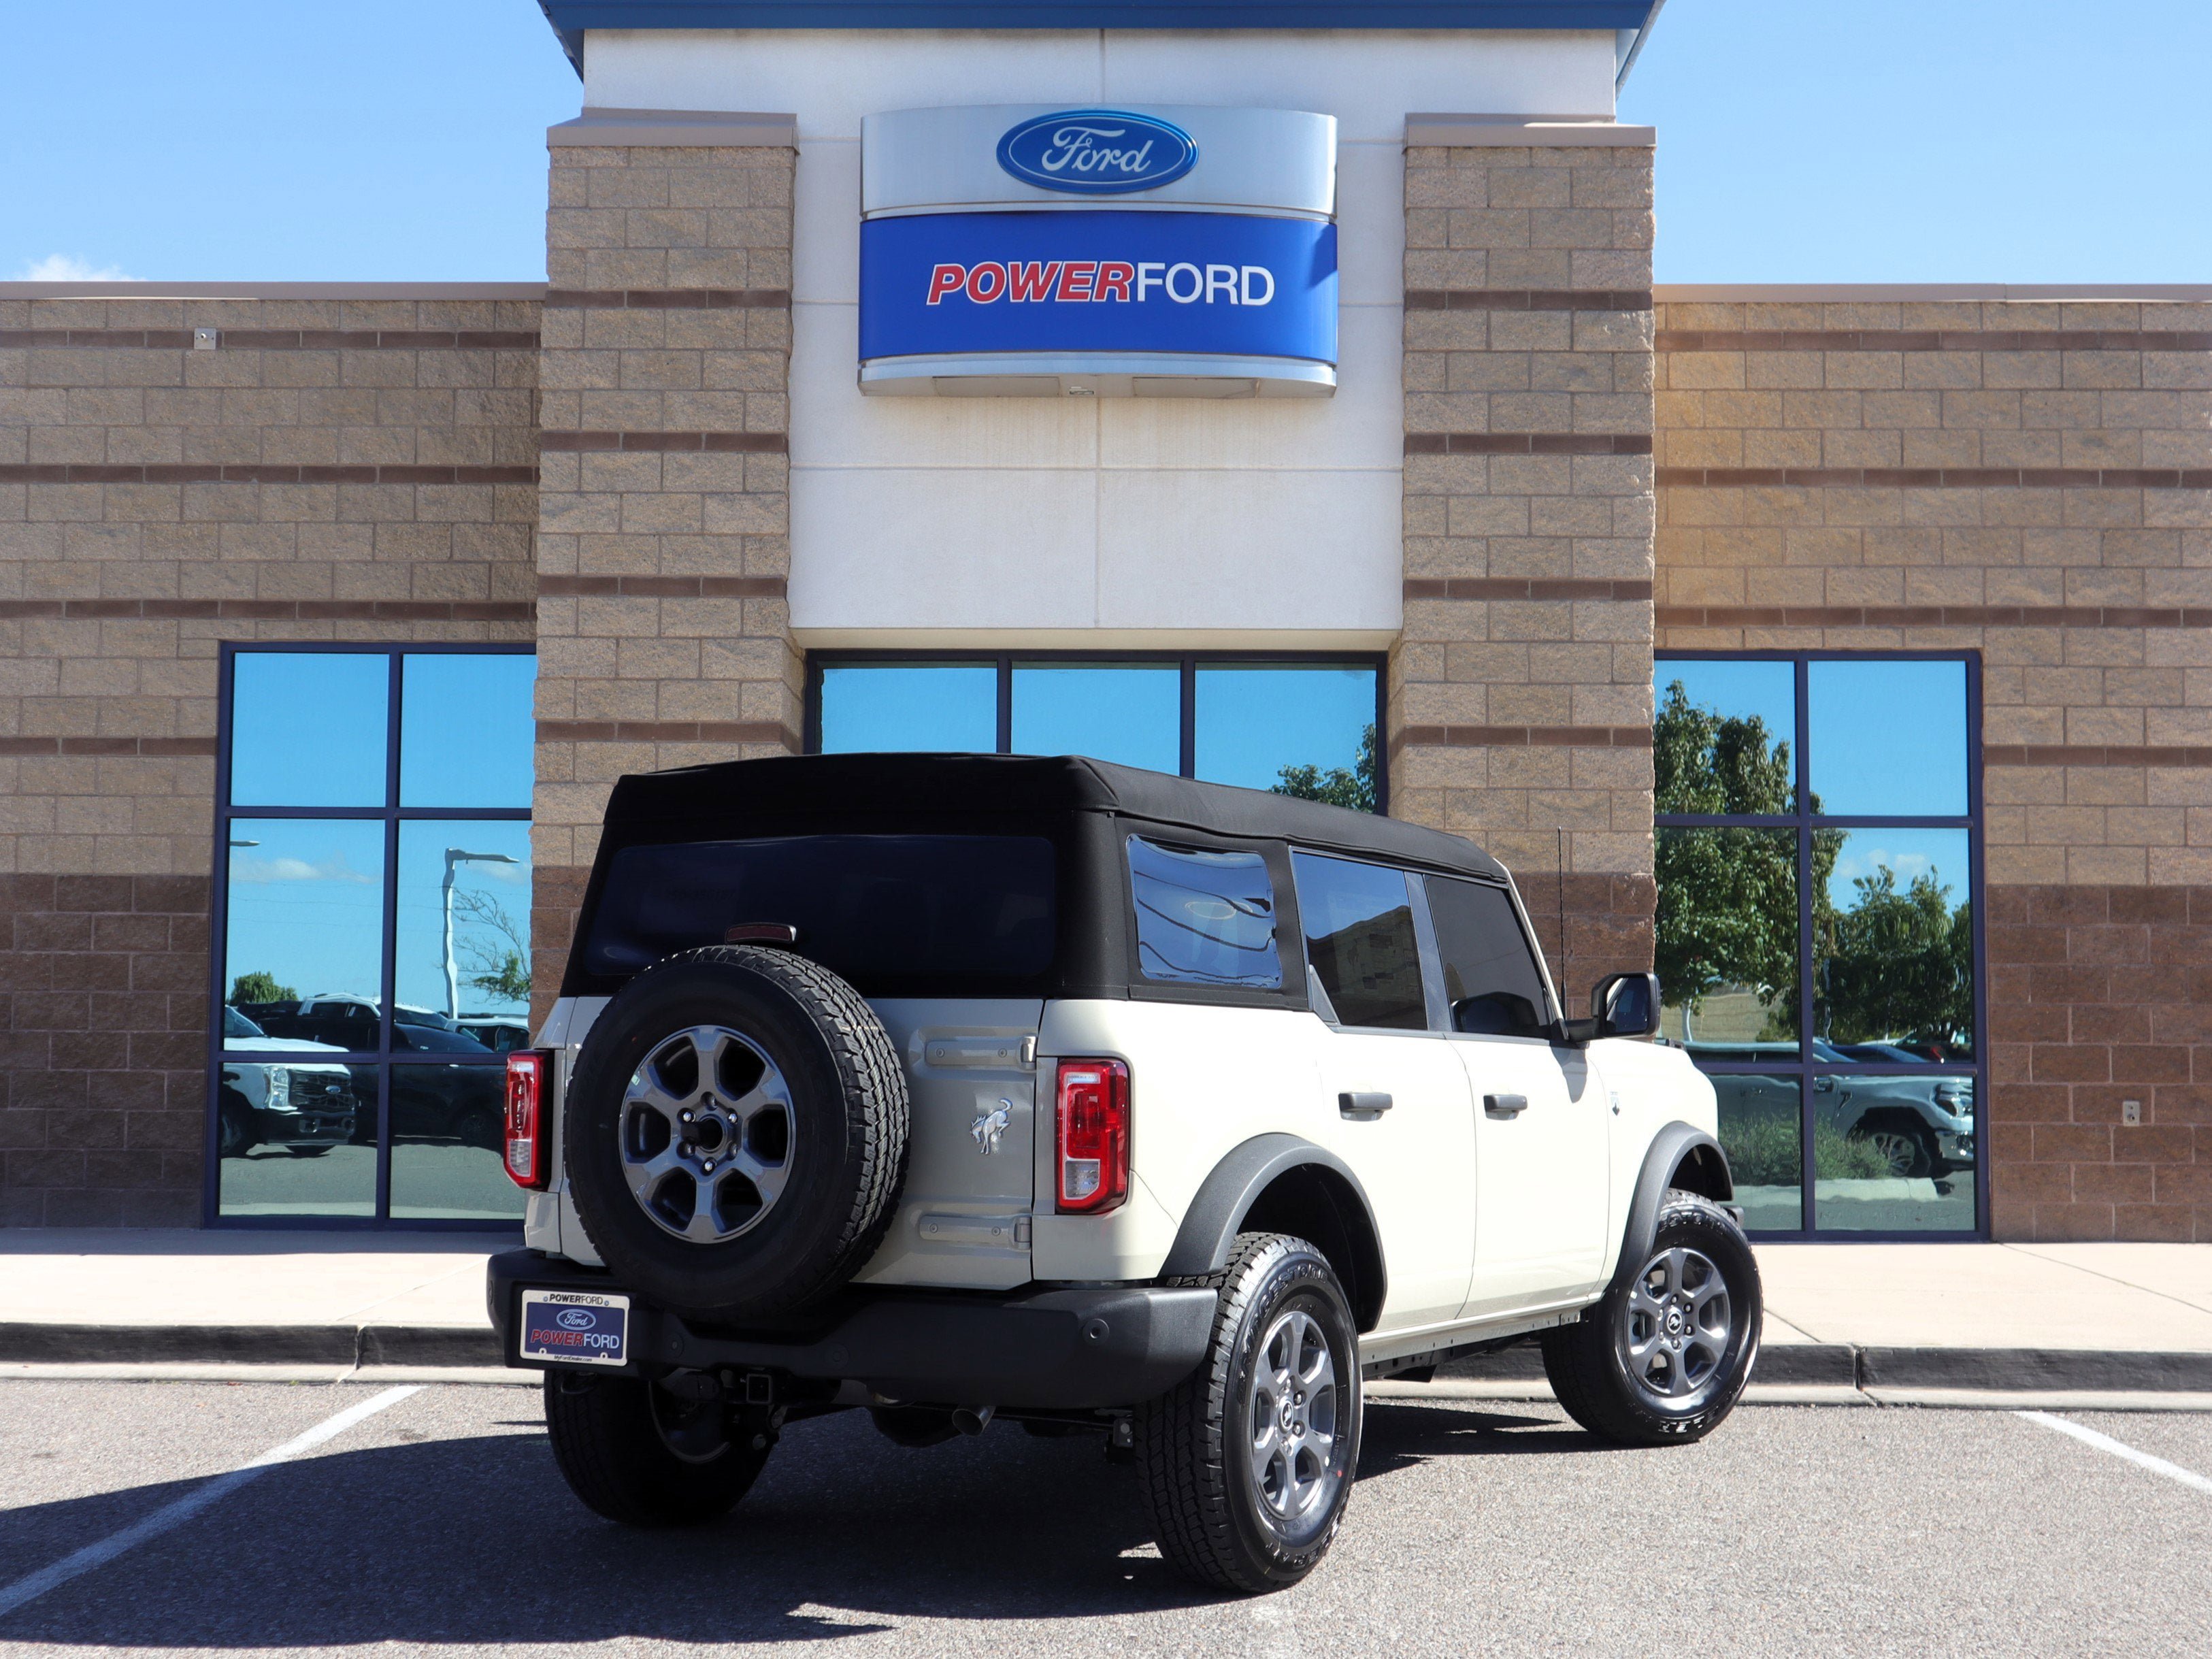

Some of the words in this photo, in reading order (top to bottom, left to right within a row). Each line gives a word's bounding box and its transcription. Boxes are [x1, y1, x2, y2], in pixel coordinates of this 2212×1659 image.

[1041, 125, 1155, 172] Ford
[549, 1294, 604, 1305] POWERFORD
[564, 1312, 587, 1326] Ford
